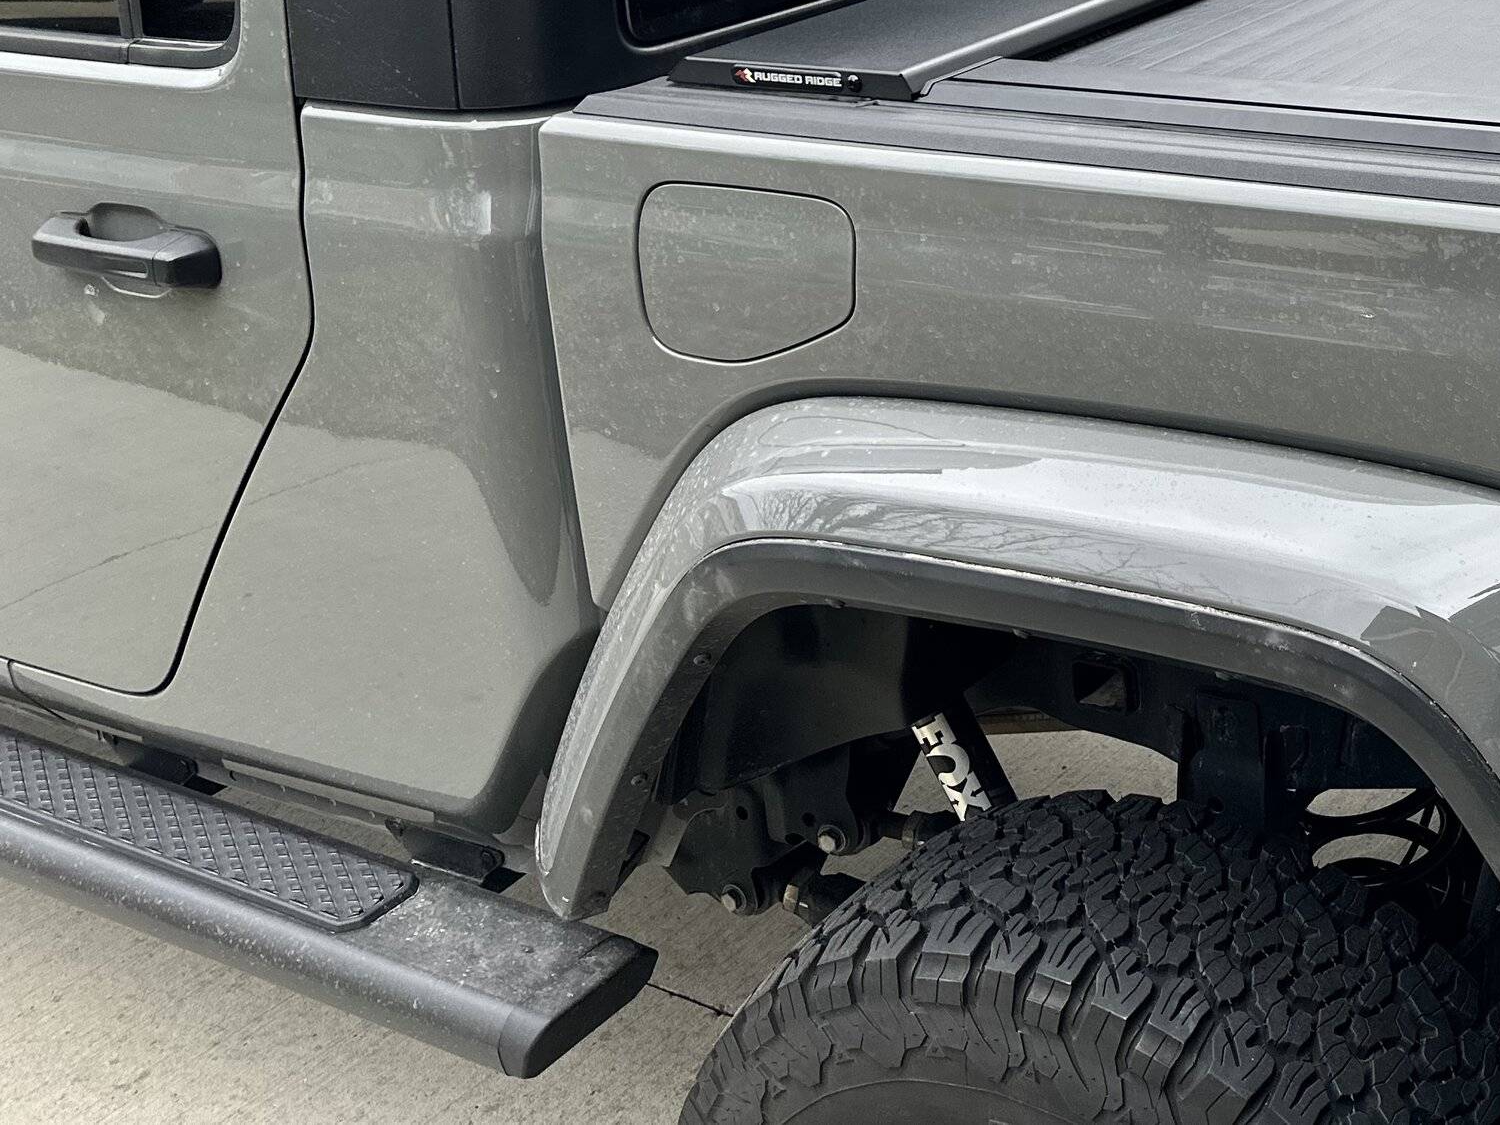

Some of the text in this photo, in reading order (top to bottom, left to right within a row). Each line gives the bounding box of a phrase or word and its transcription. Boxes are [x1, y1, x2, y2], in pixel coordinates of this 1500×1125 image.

[754, 70, 843, 88] RUGGED RIDGE
[911, 712, 993, 822] FOX
